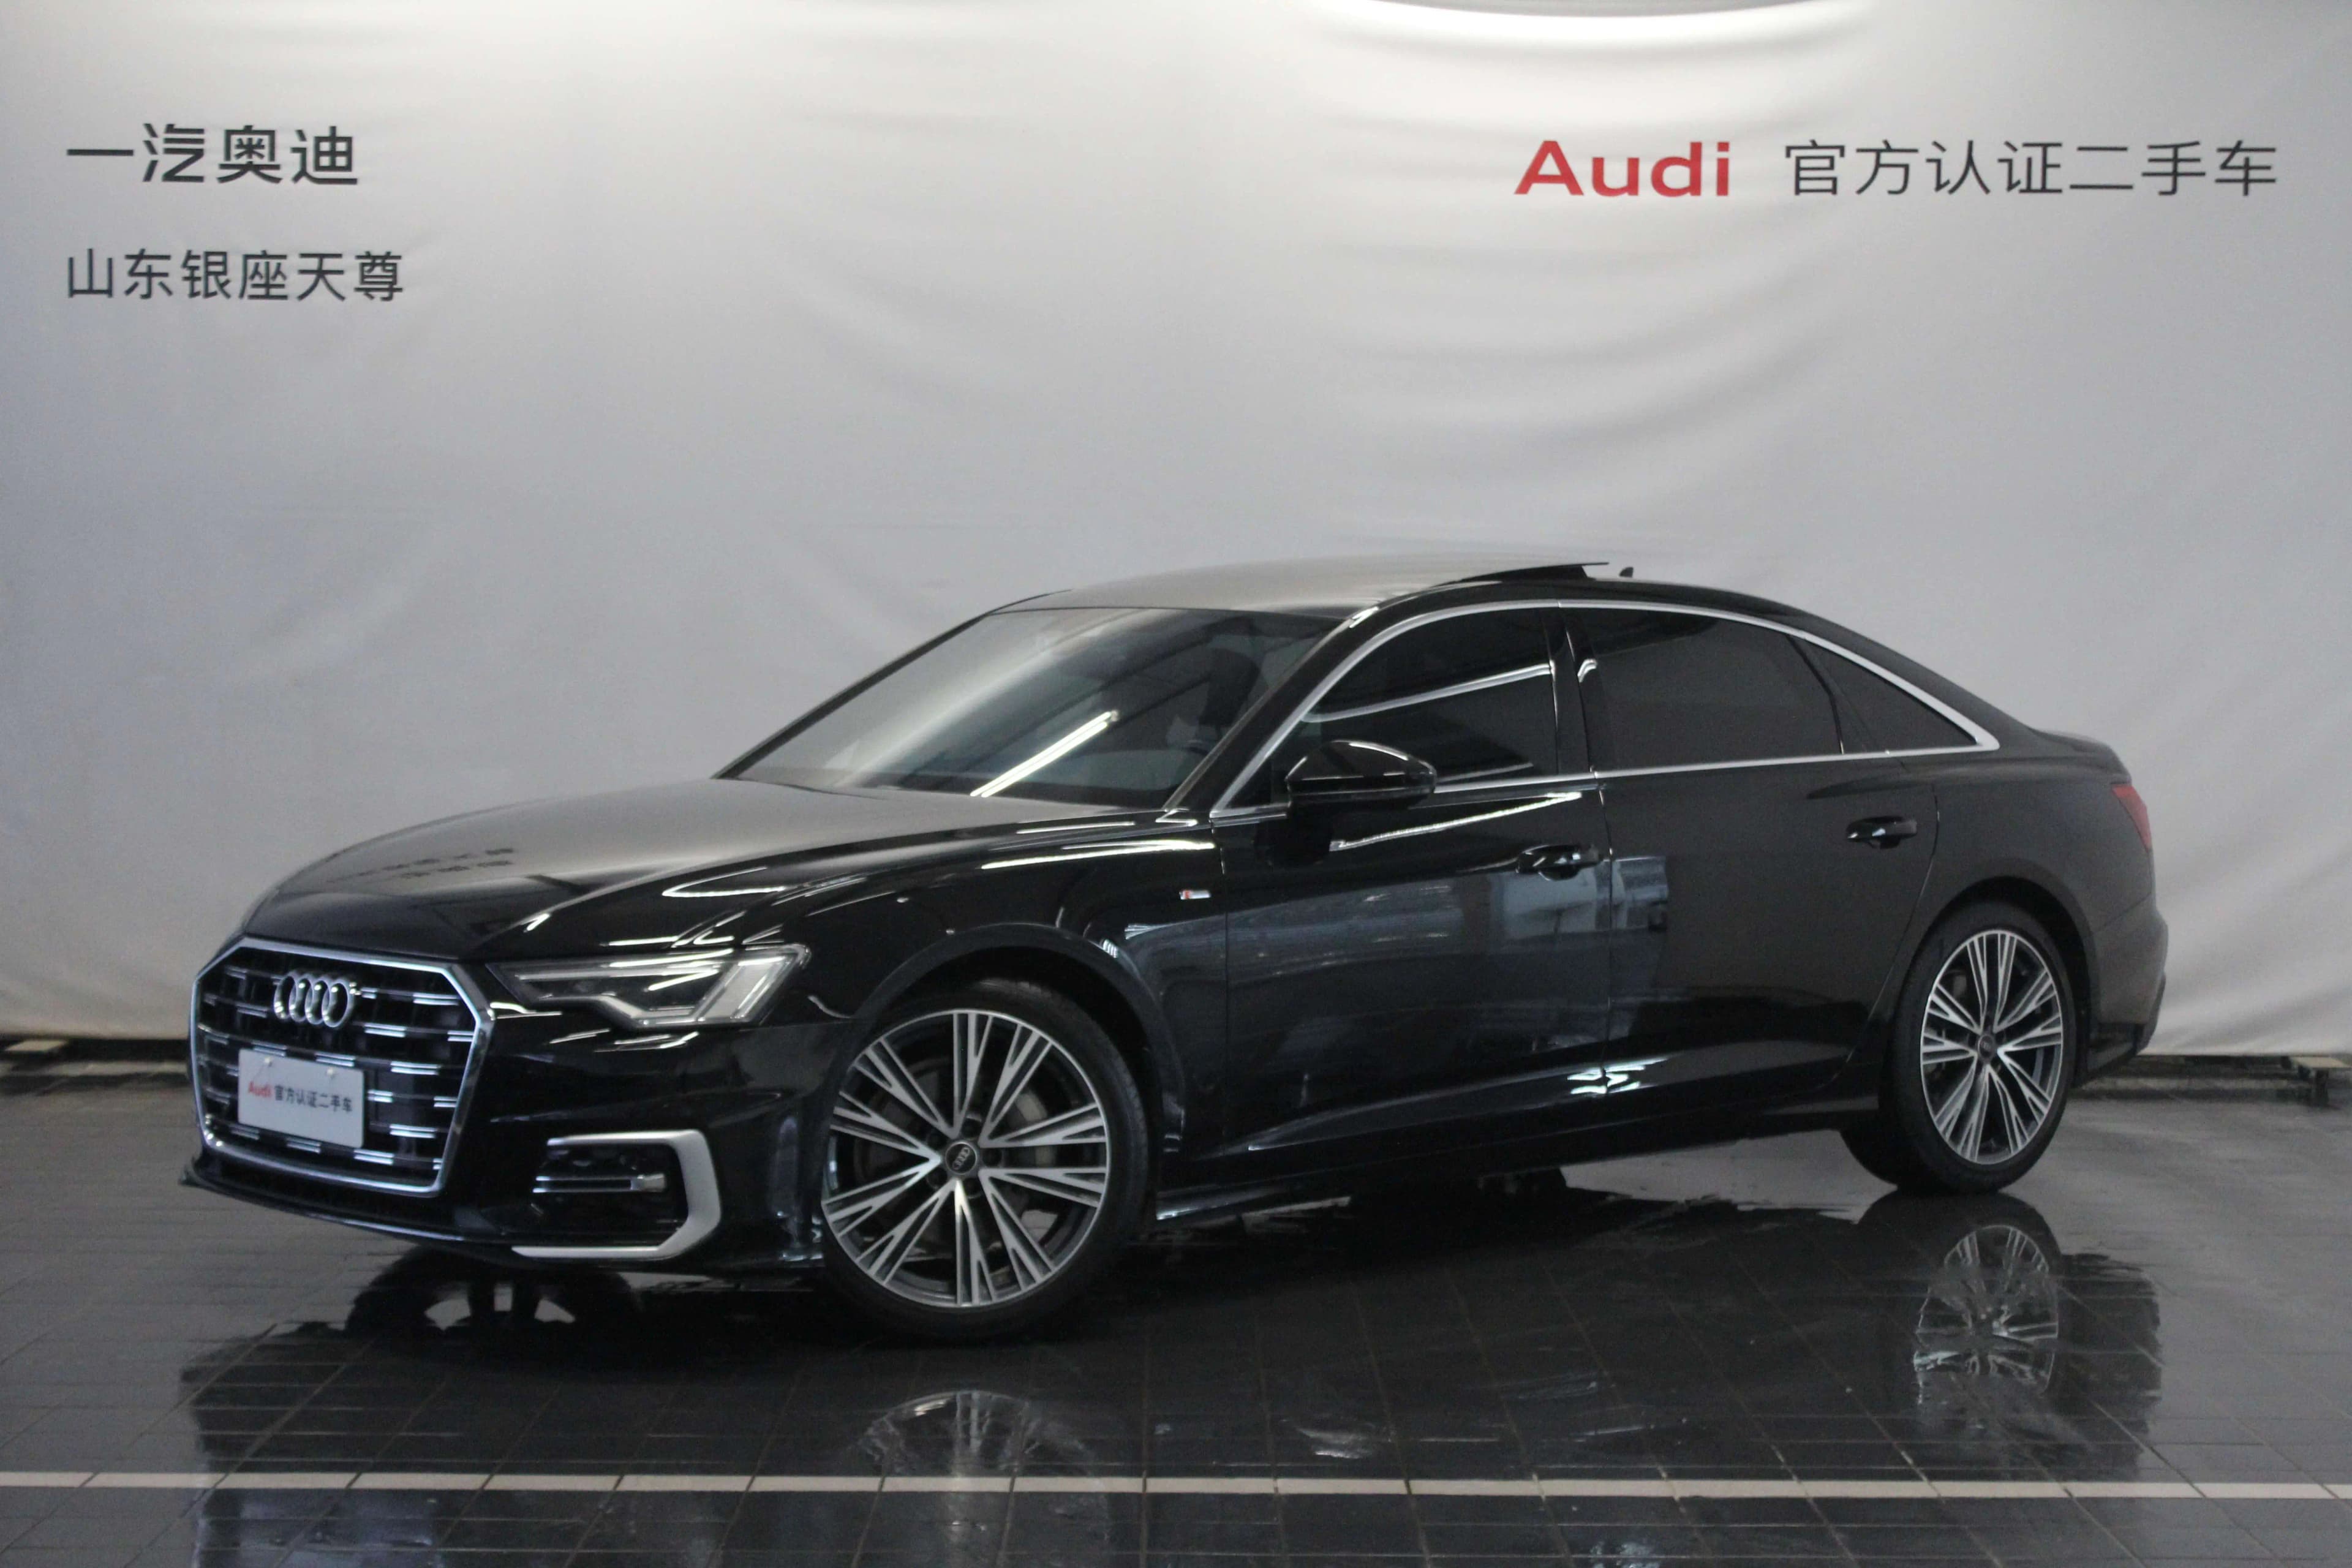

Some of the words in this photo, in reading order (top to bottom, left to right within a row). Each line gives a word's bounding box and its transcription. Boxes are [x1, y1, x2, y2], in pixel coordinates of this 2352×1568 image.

[67, 123, 358, 185] 一汽奥迪
[1516, 141, 1730, 197] Audi
[1785, 140, 2277, 197] 官方认证二手车
[67, 248, 404, 302] 山东银座天尊
[247, 1081, 272, 1098] Audi
[274, 1084, 353, 1113] 官方认证二手车
